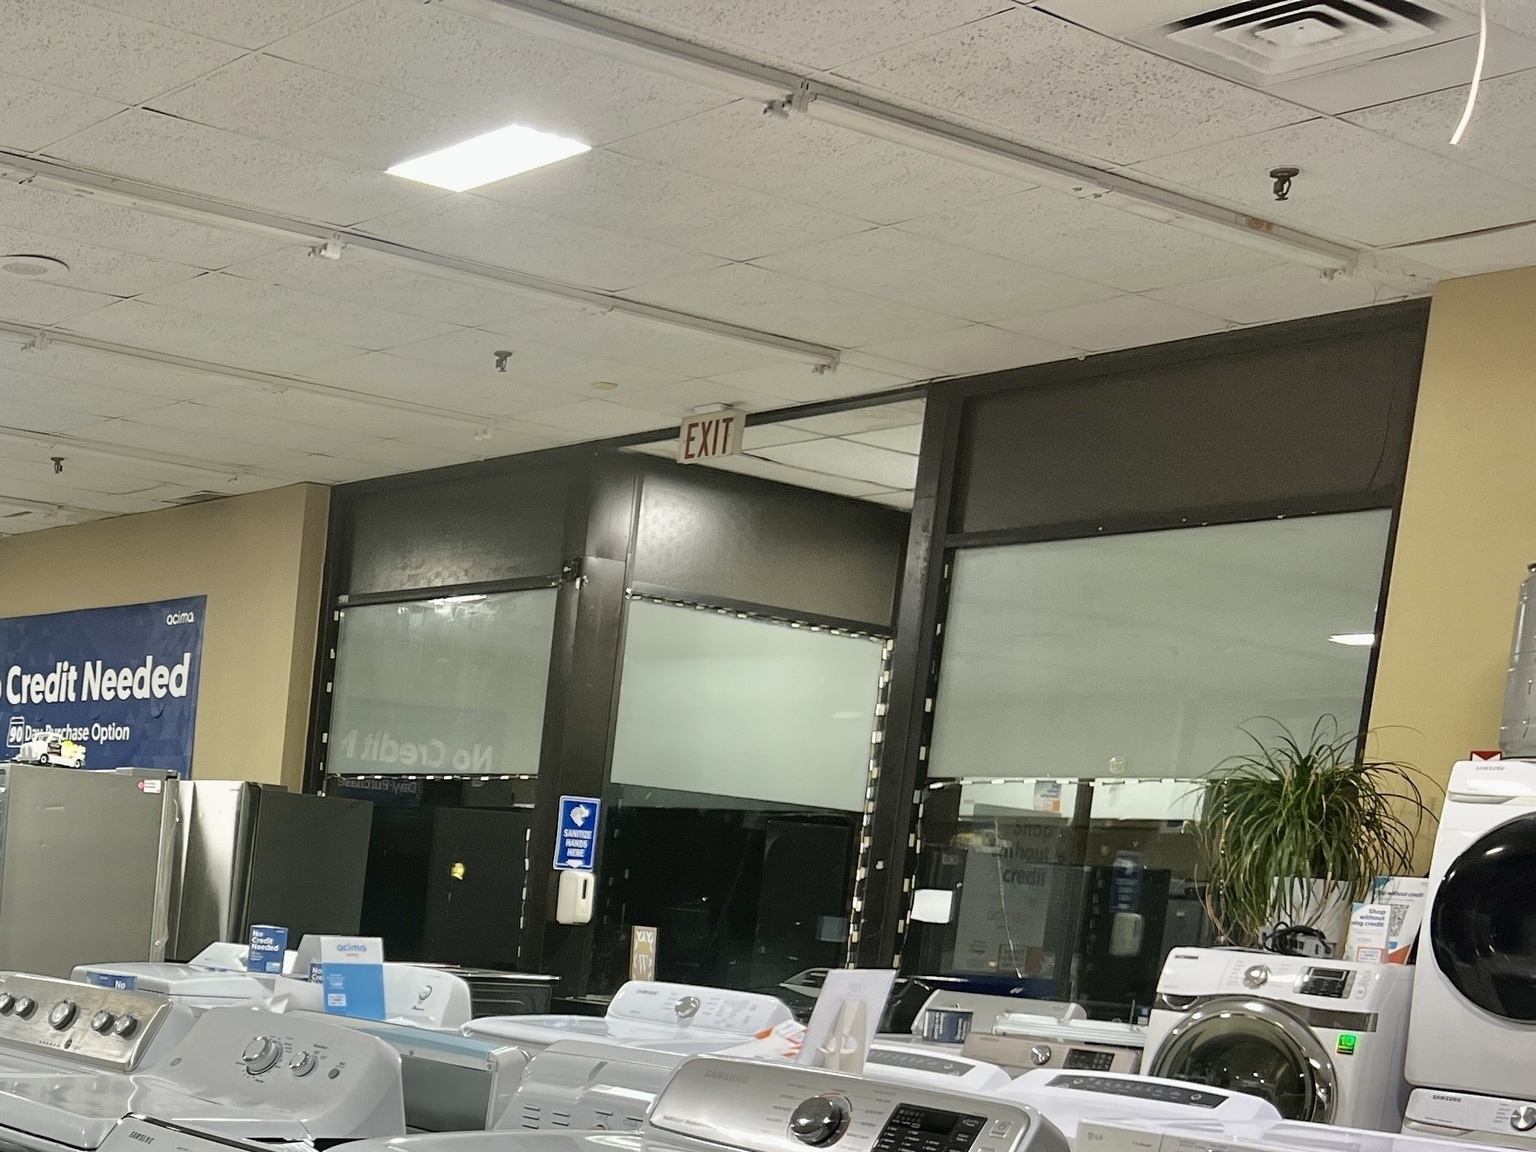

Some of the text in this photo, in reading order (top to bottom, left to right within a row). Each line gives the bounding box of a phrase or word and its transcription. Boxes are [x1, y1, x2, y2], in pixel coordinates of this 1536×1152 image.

[684, 416, 734, 460] EXIT
[166, 610, 195, 627] acima
[6, 660, 78, 705] Credit
[81, 652, 192, 701] Needed
[10, 725, 23, 743] 90
[91, 722, 130, 745] Option
[563, 828, 593, 839] SANITIZE
[565, 838, 588, 848] HANDS
[567, 847, 585, 857] HERE
[1368, 908, 1386, 916] Shop
[252, 930, 263, 938] No
[251, 937, 274, 945] Credit
[251, 943, 279, 952] Needed
[336, 942, 367, 952] acima
[311, 966, 323, 974] No
[114, 980, 126, 989] No
[703, 1069, 750, 1085] SAMSUNG
[1432, 1094, 1462, 1103] SAMSUNG
[128, 1130, 155, 1145] SAMSUNG
